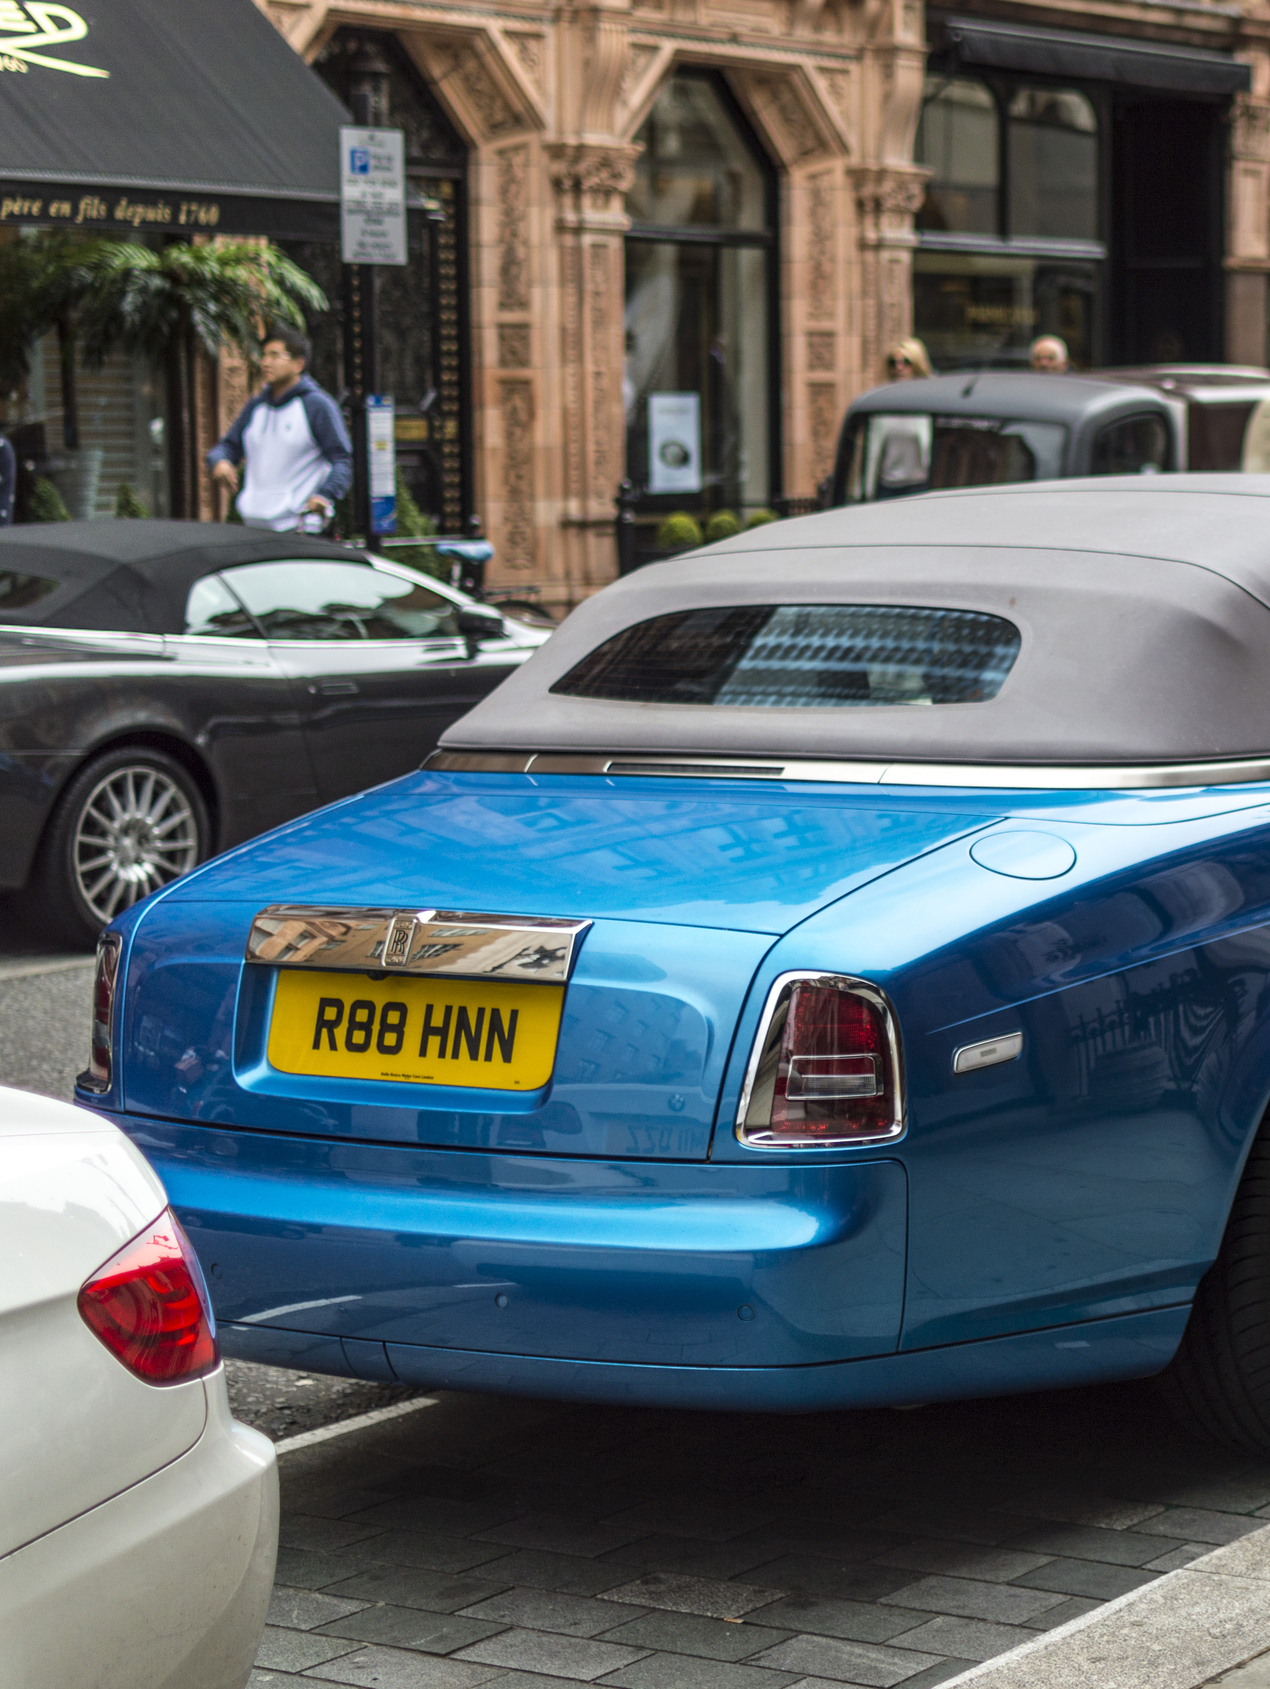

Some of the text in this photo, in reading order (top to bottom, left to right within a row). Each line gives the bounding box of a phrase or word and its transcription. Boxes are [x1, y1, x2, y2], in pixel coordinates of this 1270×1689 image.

[0, 195, 220, 227] père en fils depuis 1760
[312, 997, 519, 1064] R88 HNN
